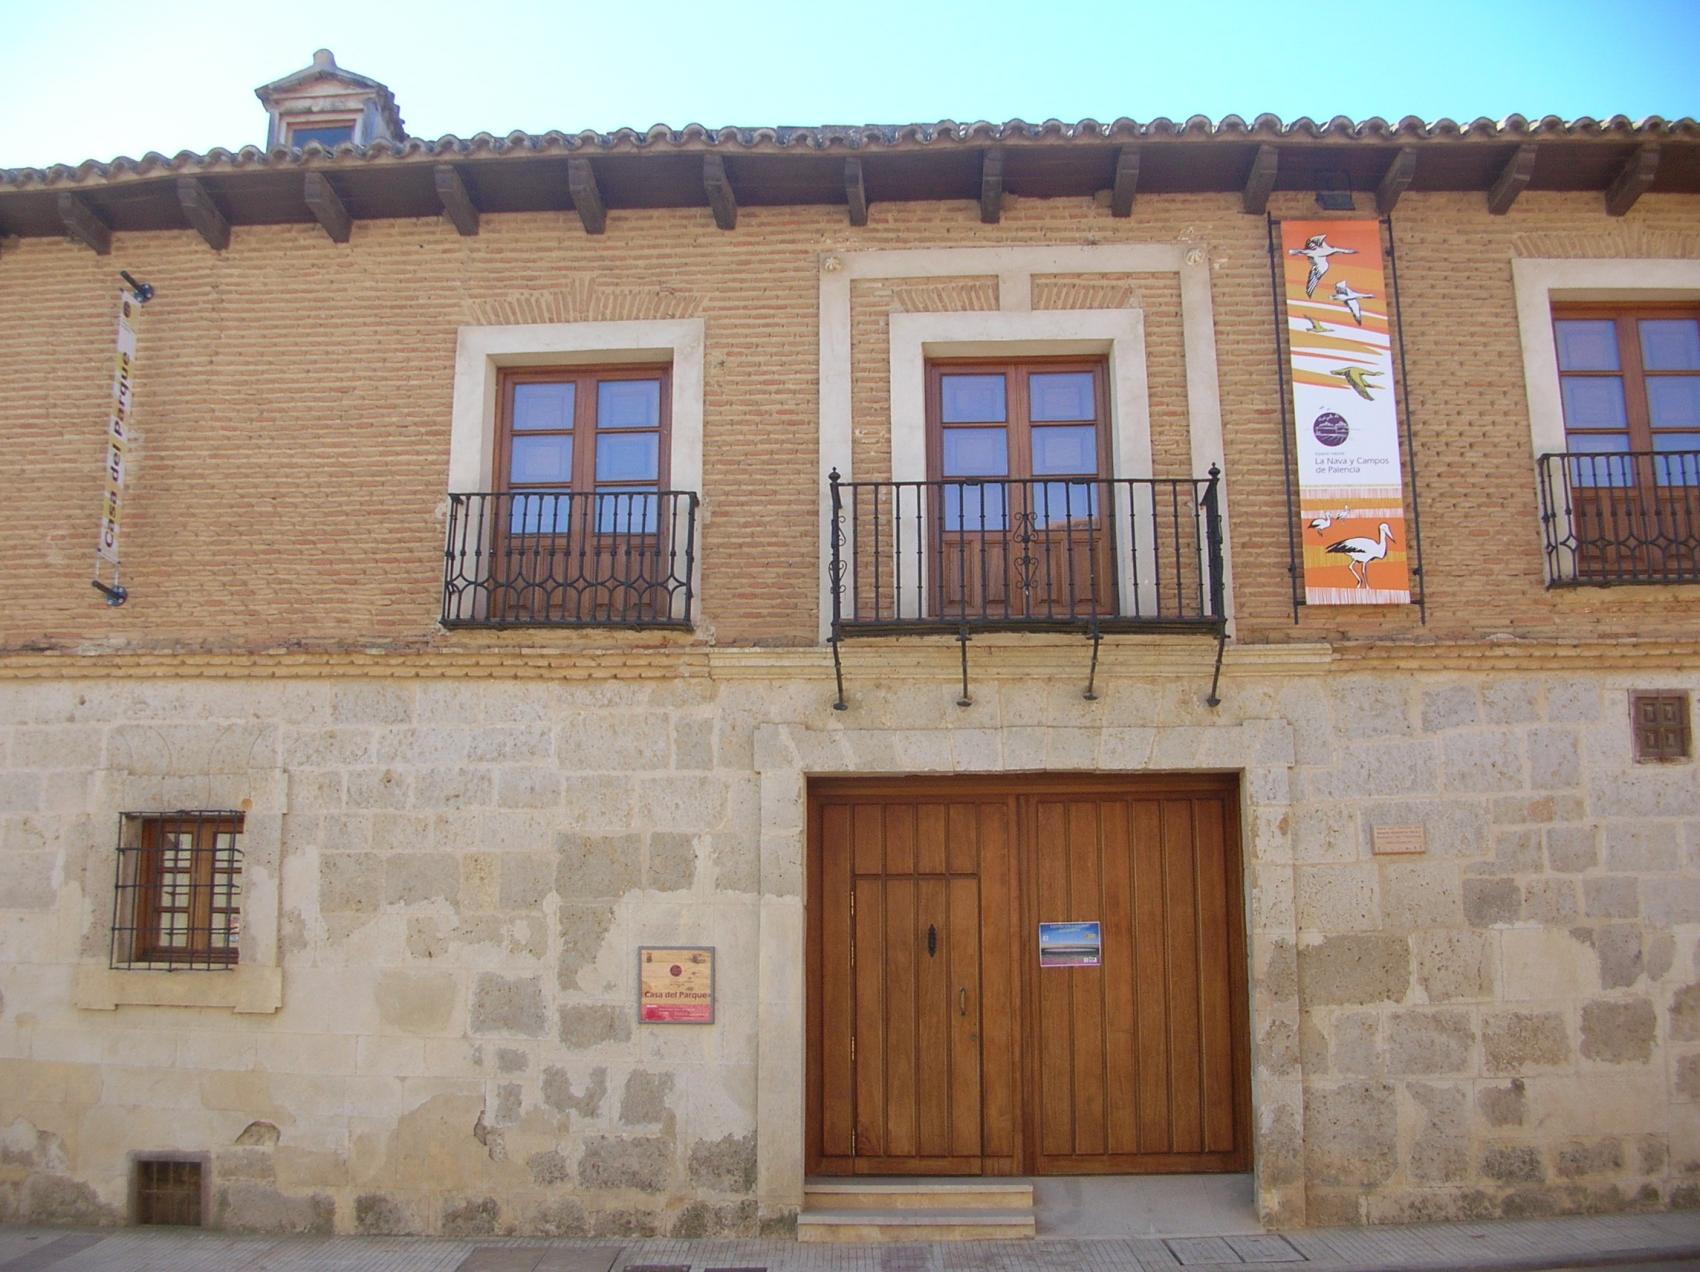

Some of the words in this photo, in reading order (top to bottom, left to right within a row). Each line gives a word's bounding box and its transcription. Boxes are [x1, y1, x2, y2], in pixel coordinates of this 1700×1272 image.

[114, 351, 130, 437] Parque
[110, 443, 121, 482] del
[1315, 457, 1324, 465] La
[1327, 457, 1347, 465] Nava
[1356, 457, 1389, 465] Campos
[105, 490, 117, 548] Casa
[679, 991, 707, 1000] Parque
